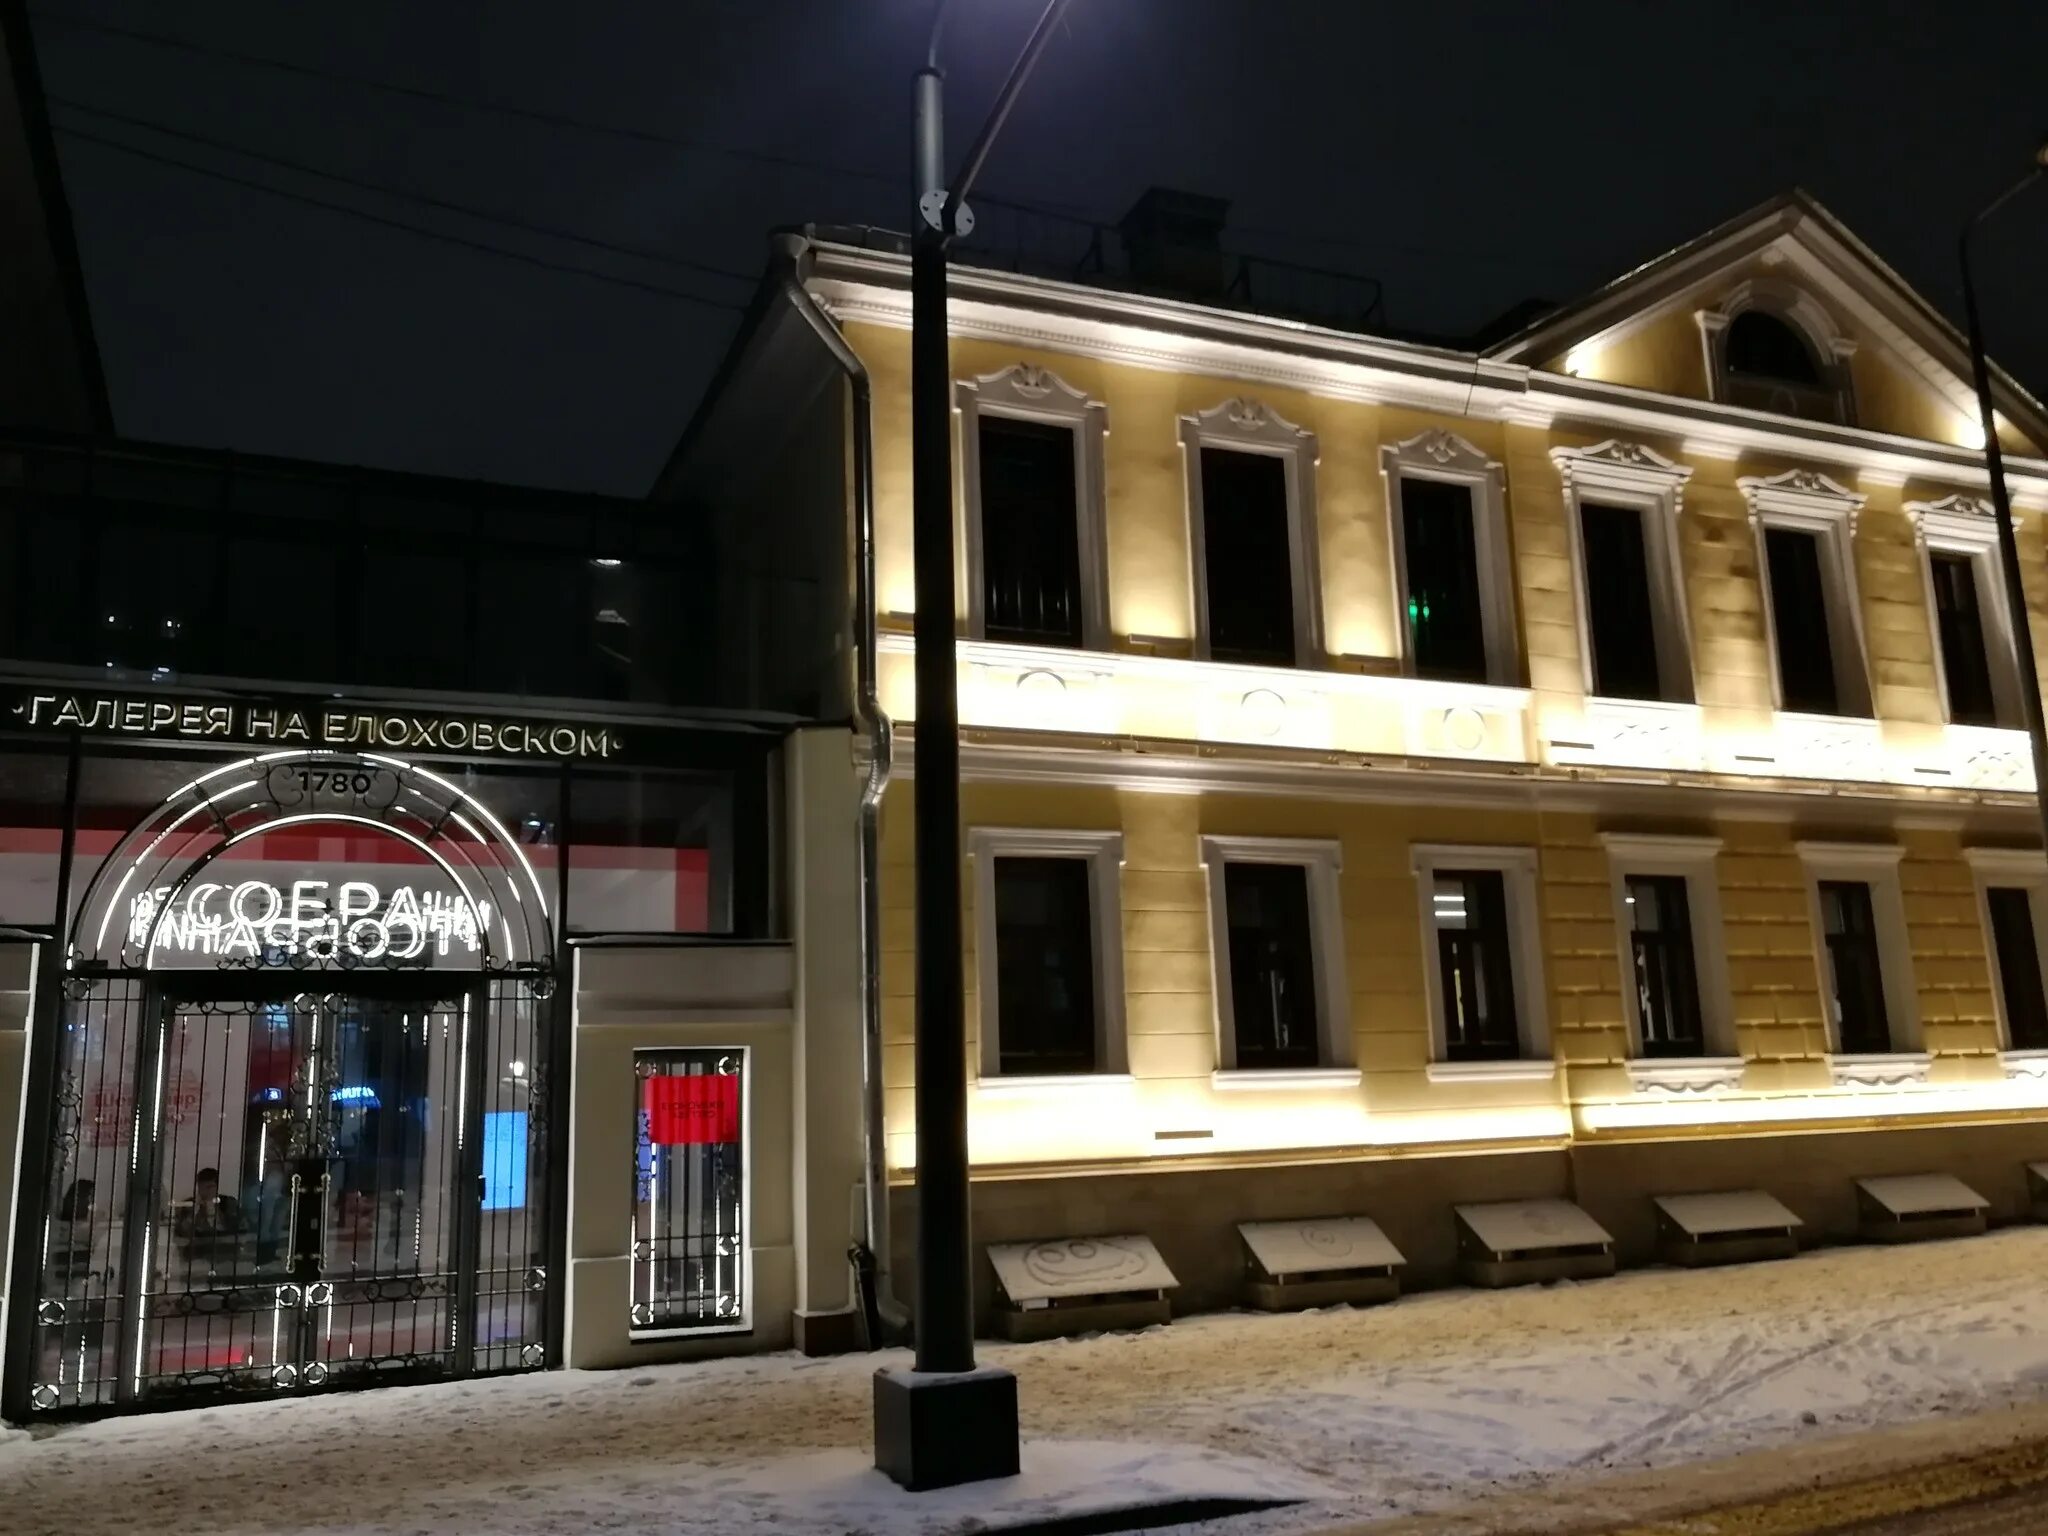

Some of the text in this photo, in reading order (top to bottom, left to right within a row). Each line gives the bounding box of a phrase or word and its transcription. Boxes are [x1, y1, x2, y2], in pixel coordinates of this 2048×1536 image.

[28, 695, 610, 758] ГАЛЕРЕЯ НА ЕЛОХОВСКОМ
[298, 771, 372, 794] 1780
